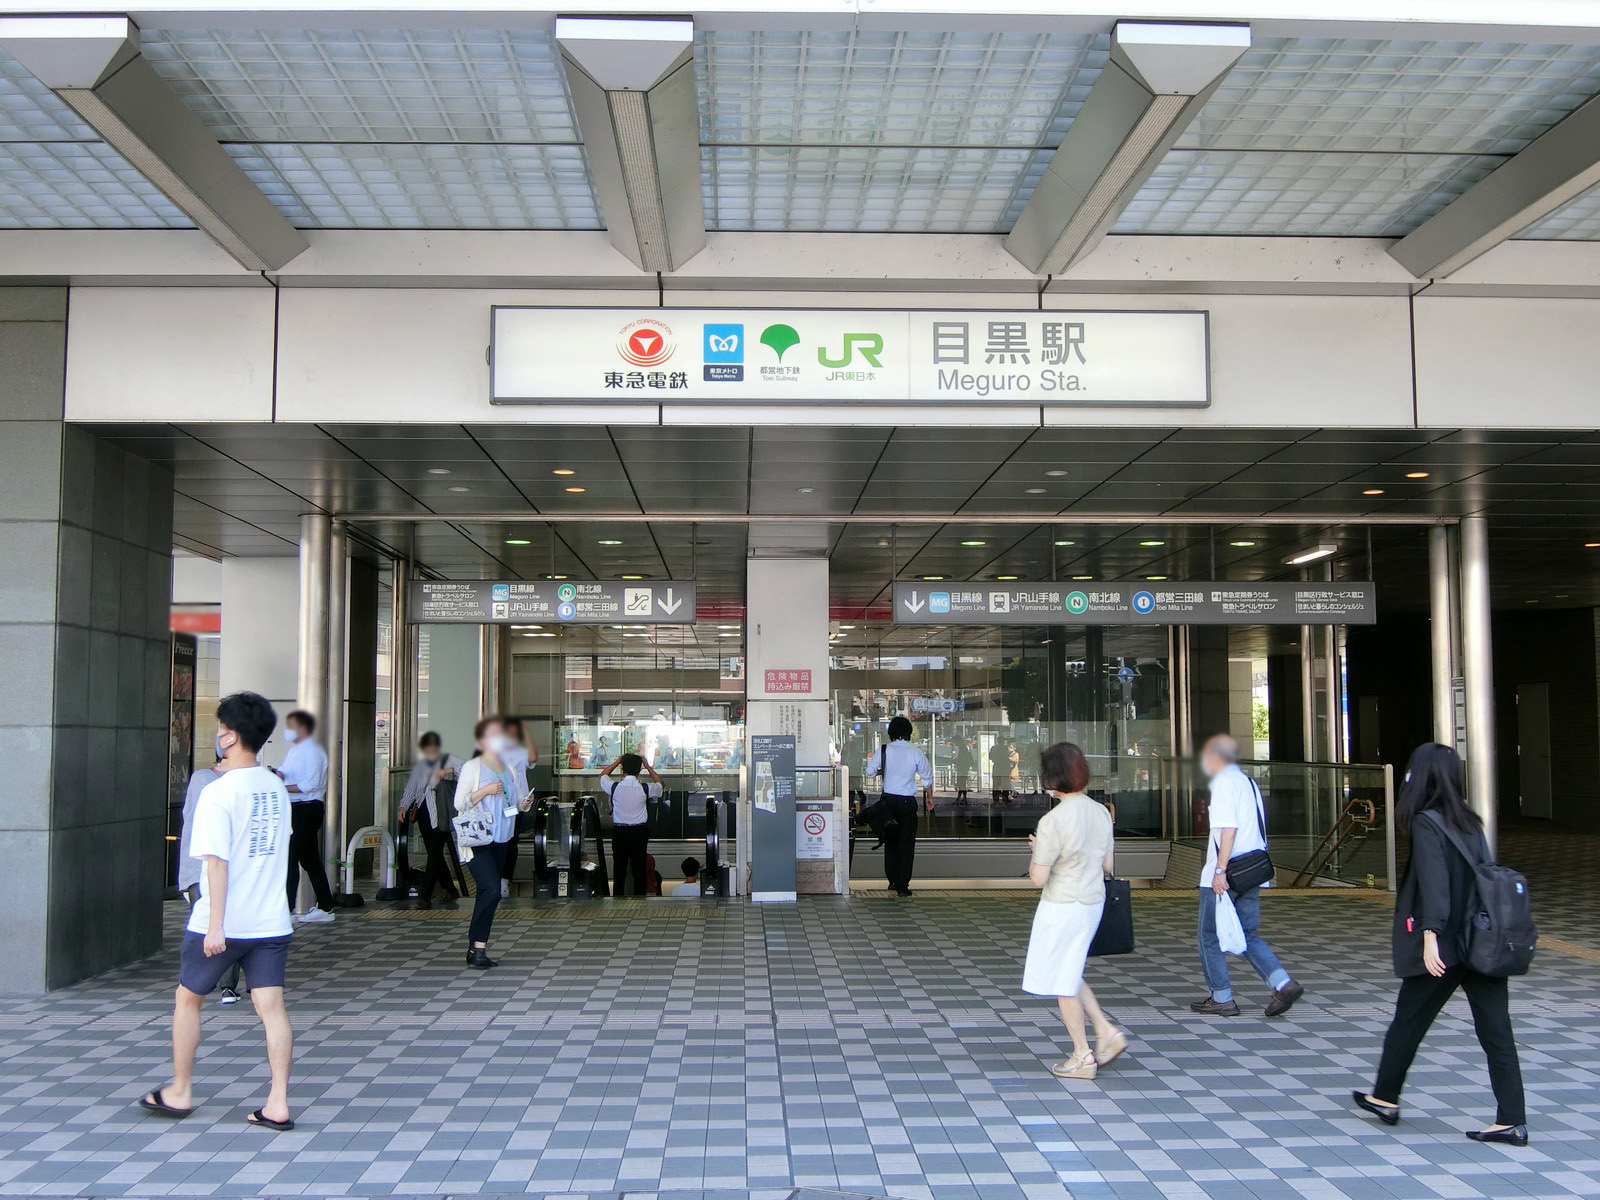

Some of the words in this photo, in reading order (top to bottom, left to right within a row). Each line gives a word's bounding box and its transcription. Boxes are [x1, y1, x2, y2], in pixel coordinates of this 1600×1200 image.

[619, 321, 635, 335] TOKYU
[636, 318, 673, 335] CORPORATION
[933, 322, 1087, 365] 目黒駅
[818, 333, 884, 368] JR
[709, 367, 738, 375] 東京メトロ
[760, 366, 800, 375] 都営地下鉄
[604, 371, 688, 389] 東急電鉄
[825, 371, 876, 381] JR東日本
[938, 369, 1031, 396] Meguro
[1040, 369, 1087, 391] Sta.
[494, 589, 508, 597] MG
[509, 584, 535, 594] 目黒線
[576, 584, 602, 594] 南北線
[931, 598, 948, 607] MG
[951, 592, 983, 603] 目黒線
[1011, 592, 1060, 603] JR山手線
[1088, 592, 1121, 603] 南北線
[1156, 592, 1204, 603] 都営三田線
[510, 602, 549, 612] JR山手線
[576, 602, 619, 612] 都営三田線
[951, 604, 972, 612] Meguro
[767, 671, 809, 681] 危険物品
[767, 682, 809, 691] 持込み厳禁
